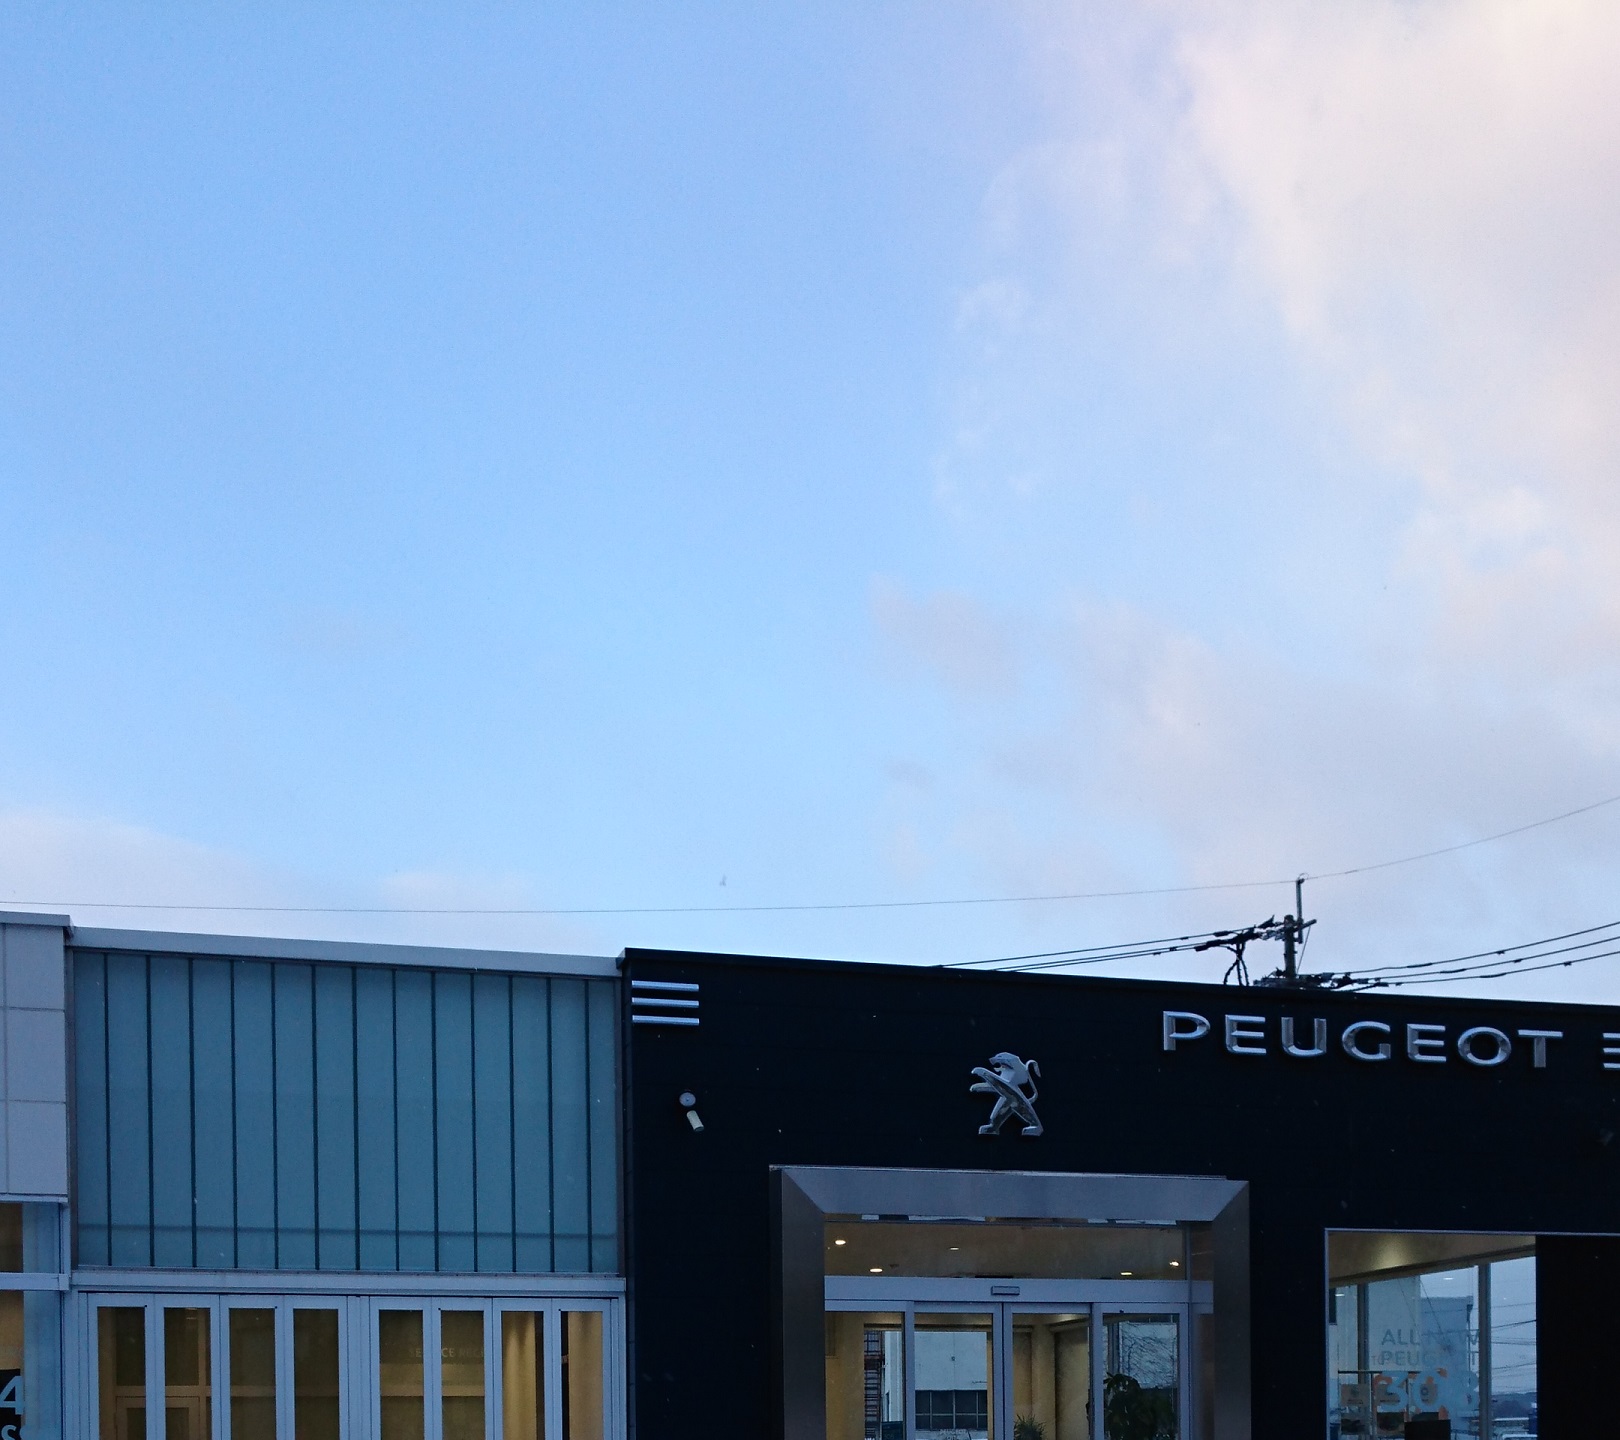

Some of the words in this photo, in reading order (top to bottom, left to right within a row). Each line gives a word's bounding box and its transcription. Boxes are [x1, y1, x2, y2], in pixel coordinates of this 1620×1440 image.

[1162, 1010, 1563, 1068] PEUGEOT
[1382, 1329, 1420, 1345] ALL
[1424, 1330, 1480, 1345] NW
[1380, 1350, 1479, 1366] PEUGT
